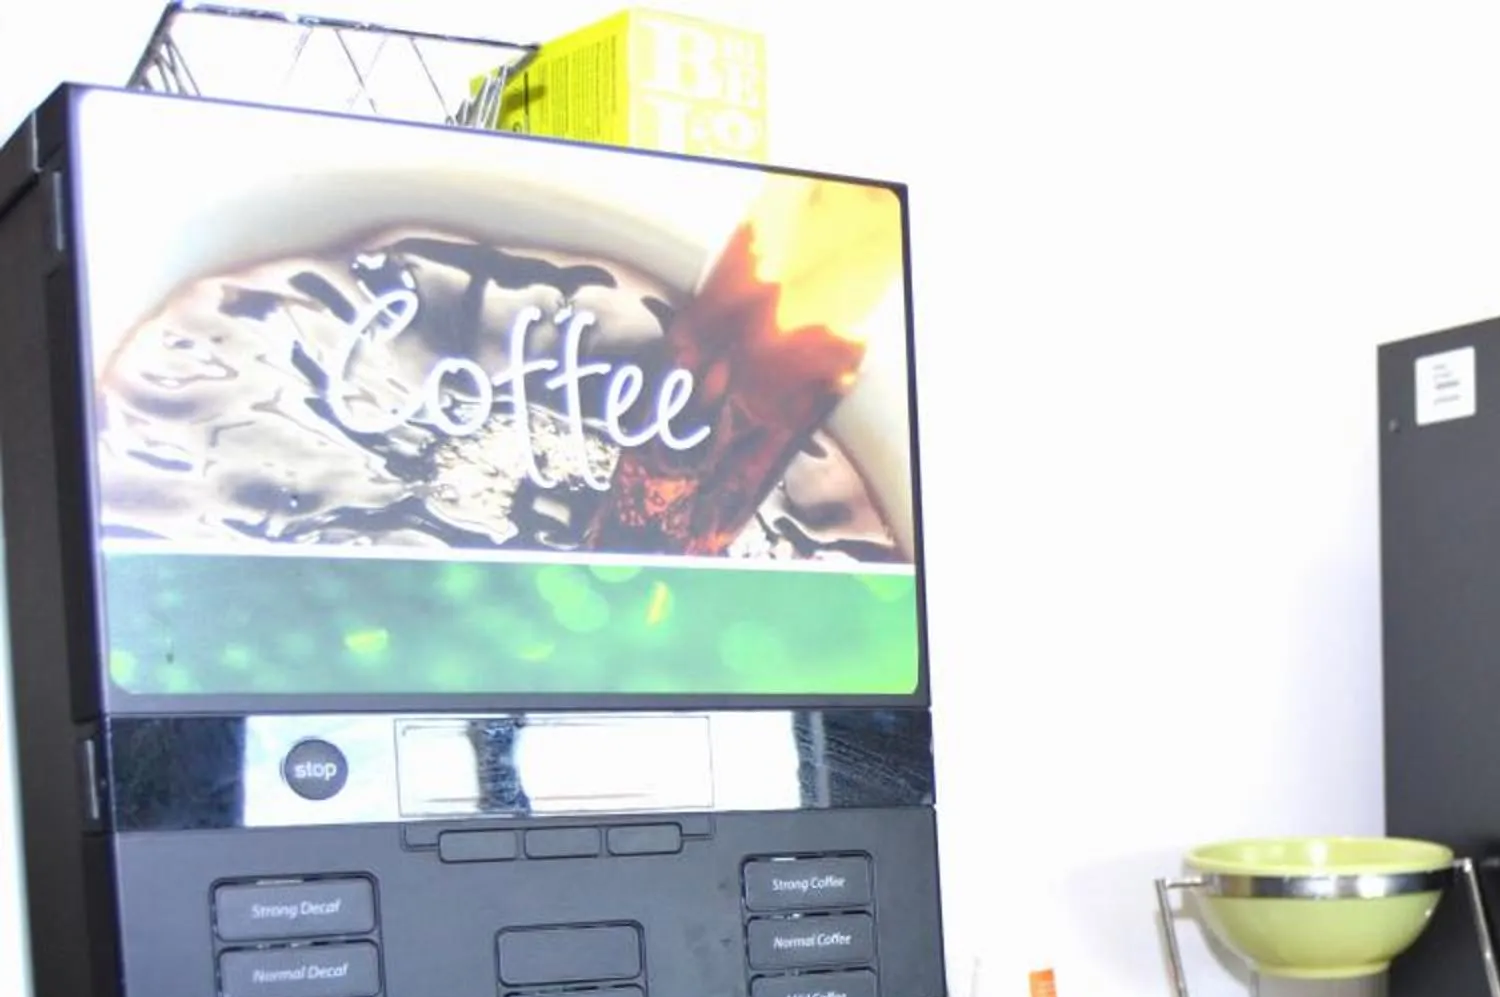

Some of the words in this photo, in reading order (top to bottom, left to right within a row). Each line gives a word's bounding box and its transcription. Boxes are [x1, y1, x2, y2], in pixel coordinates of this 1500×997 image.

[325, 286, 712, 490] Coffee
[293, 760, 338, 781] stop
[771, 877, 809, 894] Strong
[810, 875, 846, 890] Coffee
[251, 902, 298, 919] Strong
[300, 899, 342, 915] Decaf
[772, 935, 815, 950] Normal
[816, 932, 852, 946] Coffee
[252, 966, 306, 984] Normal
[307, 963, 349, 980] Decaf
